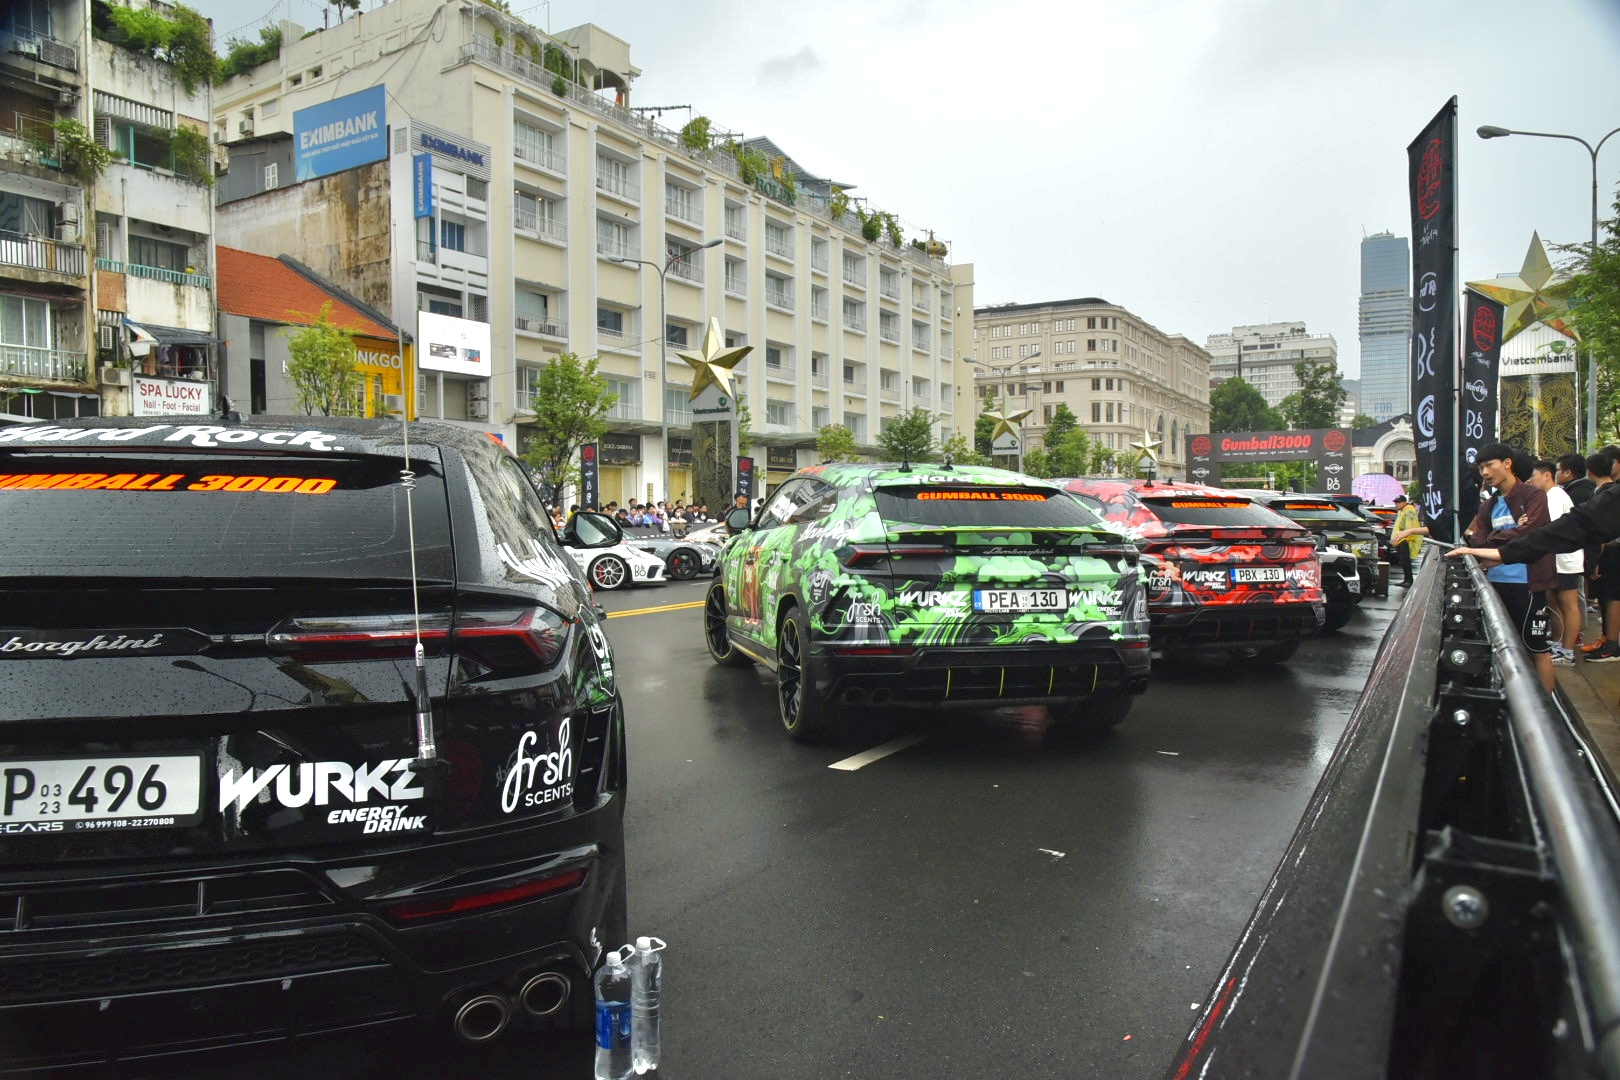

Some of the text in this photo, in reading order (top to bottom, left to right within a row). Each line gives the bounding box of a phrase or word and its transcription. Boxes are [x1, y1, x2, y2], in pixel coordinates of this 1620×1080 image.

[300, 111, 378, 150] EXIMBANK
[421, 133, 484, 167] EXIMBANK
[343, 350, 401, 369] INKGO
[1501, 352, 1574, 366] Vietcombank
[140, 383, 202, 400] SPA LUCKY
[143, 400, 157, 409] Nail
[162, 400, 177, 410] Foot
[182, 402, 201, 412] Facial
[1221, 434, 1313, 451] Gumball3000
[187, 473, 338, 494] 3000
[917, 492, 1049, 502] GUMBALL 3000
[1182, 571, 1226, 582] WURKZ
[1239, 569, 1280, 580] PBX 130
[847, 591, 881, 622] frsh
[900, 590, 968, 606] WURKZ
[988, 592, 1058, 608] PEA 130
[1068, 590, 1124, 606] WURKZ
[0, 634, 163, 656] borghini
[501, 717, 572, 813] frsh
[40, 783, 62, 797] 03
[68, 764, 167, 813] 496
[219, 758, 425, 813] WURKZ
[525, 783, 571, 807] SCENTS
[39, 800, 61, 815] 23
[327, 805, 409, 824] ENERGY
[362, 815, 428, 834] DRINK
